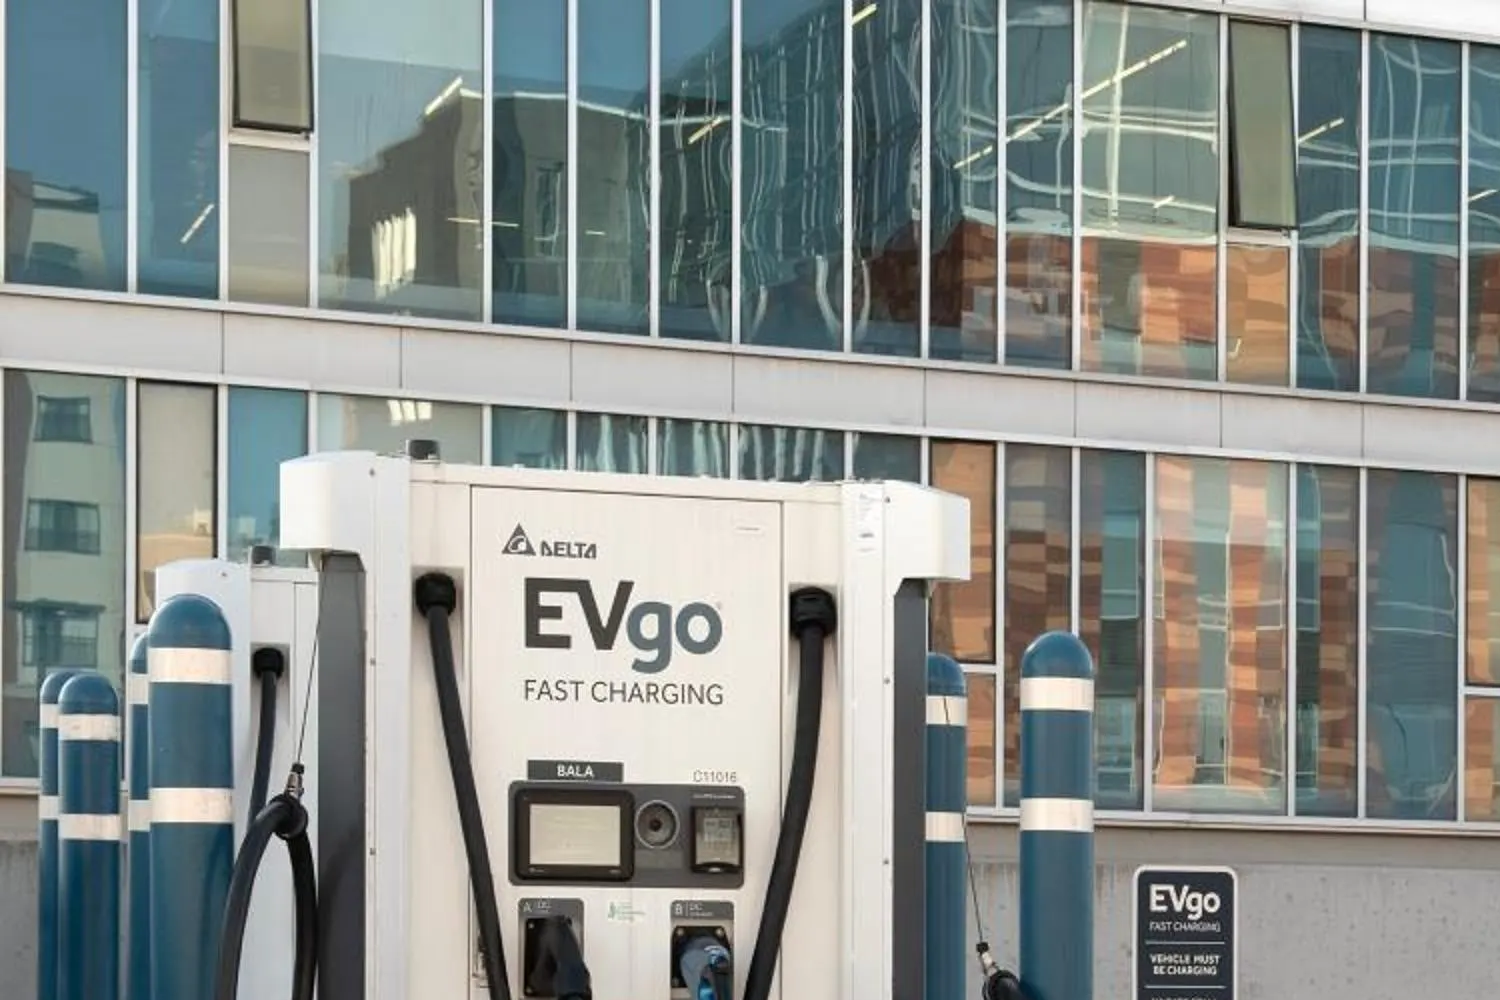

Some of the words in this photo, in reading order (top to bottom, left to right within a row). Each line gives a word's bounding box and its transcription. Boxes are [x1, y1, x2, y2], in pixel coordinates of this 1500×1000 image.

[541, 540, 597, 559] DELTA
[524, 577, 723, 674] EVgo
[524, 679, 584, 701] FAST
[591, 681, 723, 705] CHARGING
[557, 764, 594, 778] BALA
[1150, 884, 1221, 920] EVgo
[1149, 921, 1171, 932] FAST
[1173, 921, 1221, 932] CHARGING
[1150, 954, 1190, 964] VEHICLE
[1193, 954, 1220, 965] MUST
[1153, 965, 1165, 975] BE
[1167, 965, 1217, 975] CHARGING
